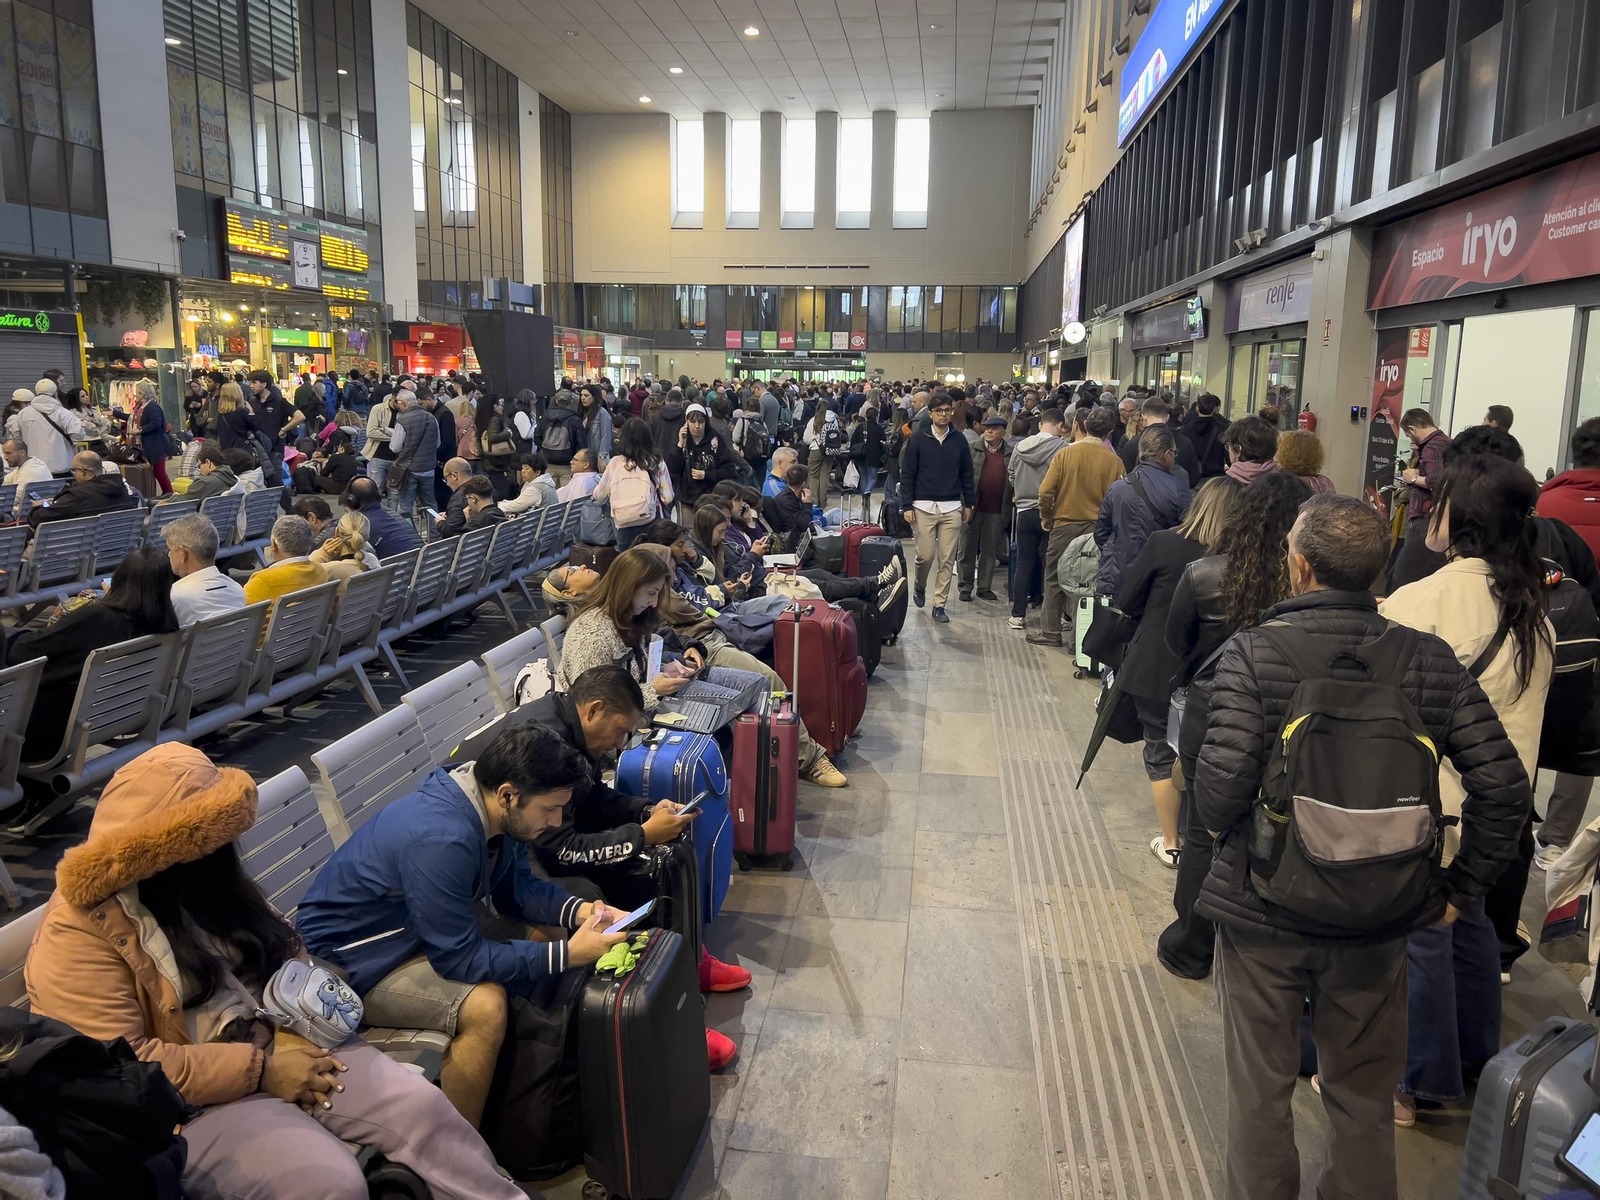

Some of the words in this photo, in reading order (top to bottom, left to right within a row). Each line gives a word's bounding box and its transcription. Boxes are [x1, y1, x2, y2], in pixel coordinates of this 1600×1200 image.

[1543, 205, 1578, 227] Atención
[1578, 201, 1587, 216] al
[1462, 212, 1517, 277] iryo
[1548, 224, 1586, 241] Customer
[1412, 243, 1444, 270] Espacio
[1266, 272, 1295, 312] renfe
[0, 313, 34, 328] atura
[1380, 359, 1399, 388] iryo
[1396, 795, 1420, 803] newfeel
